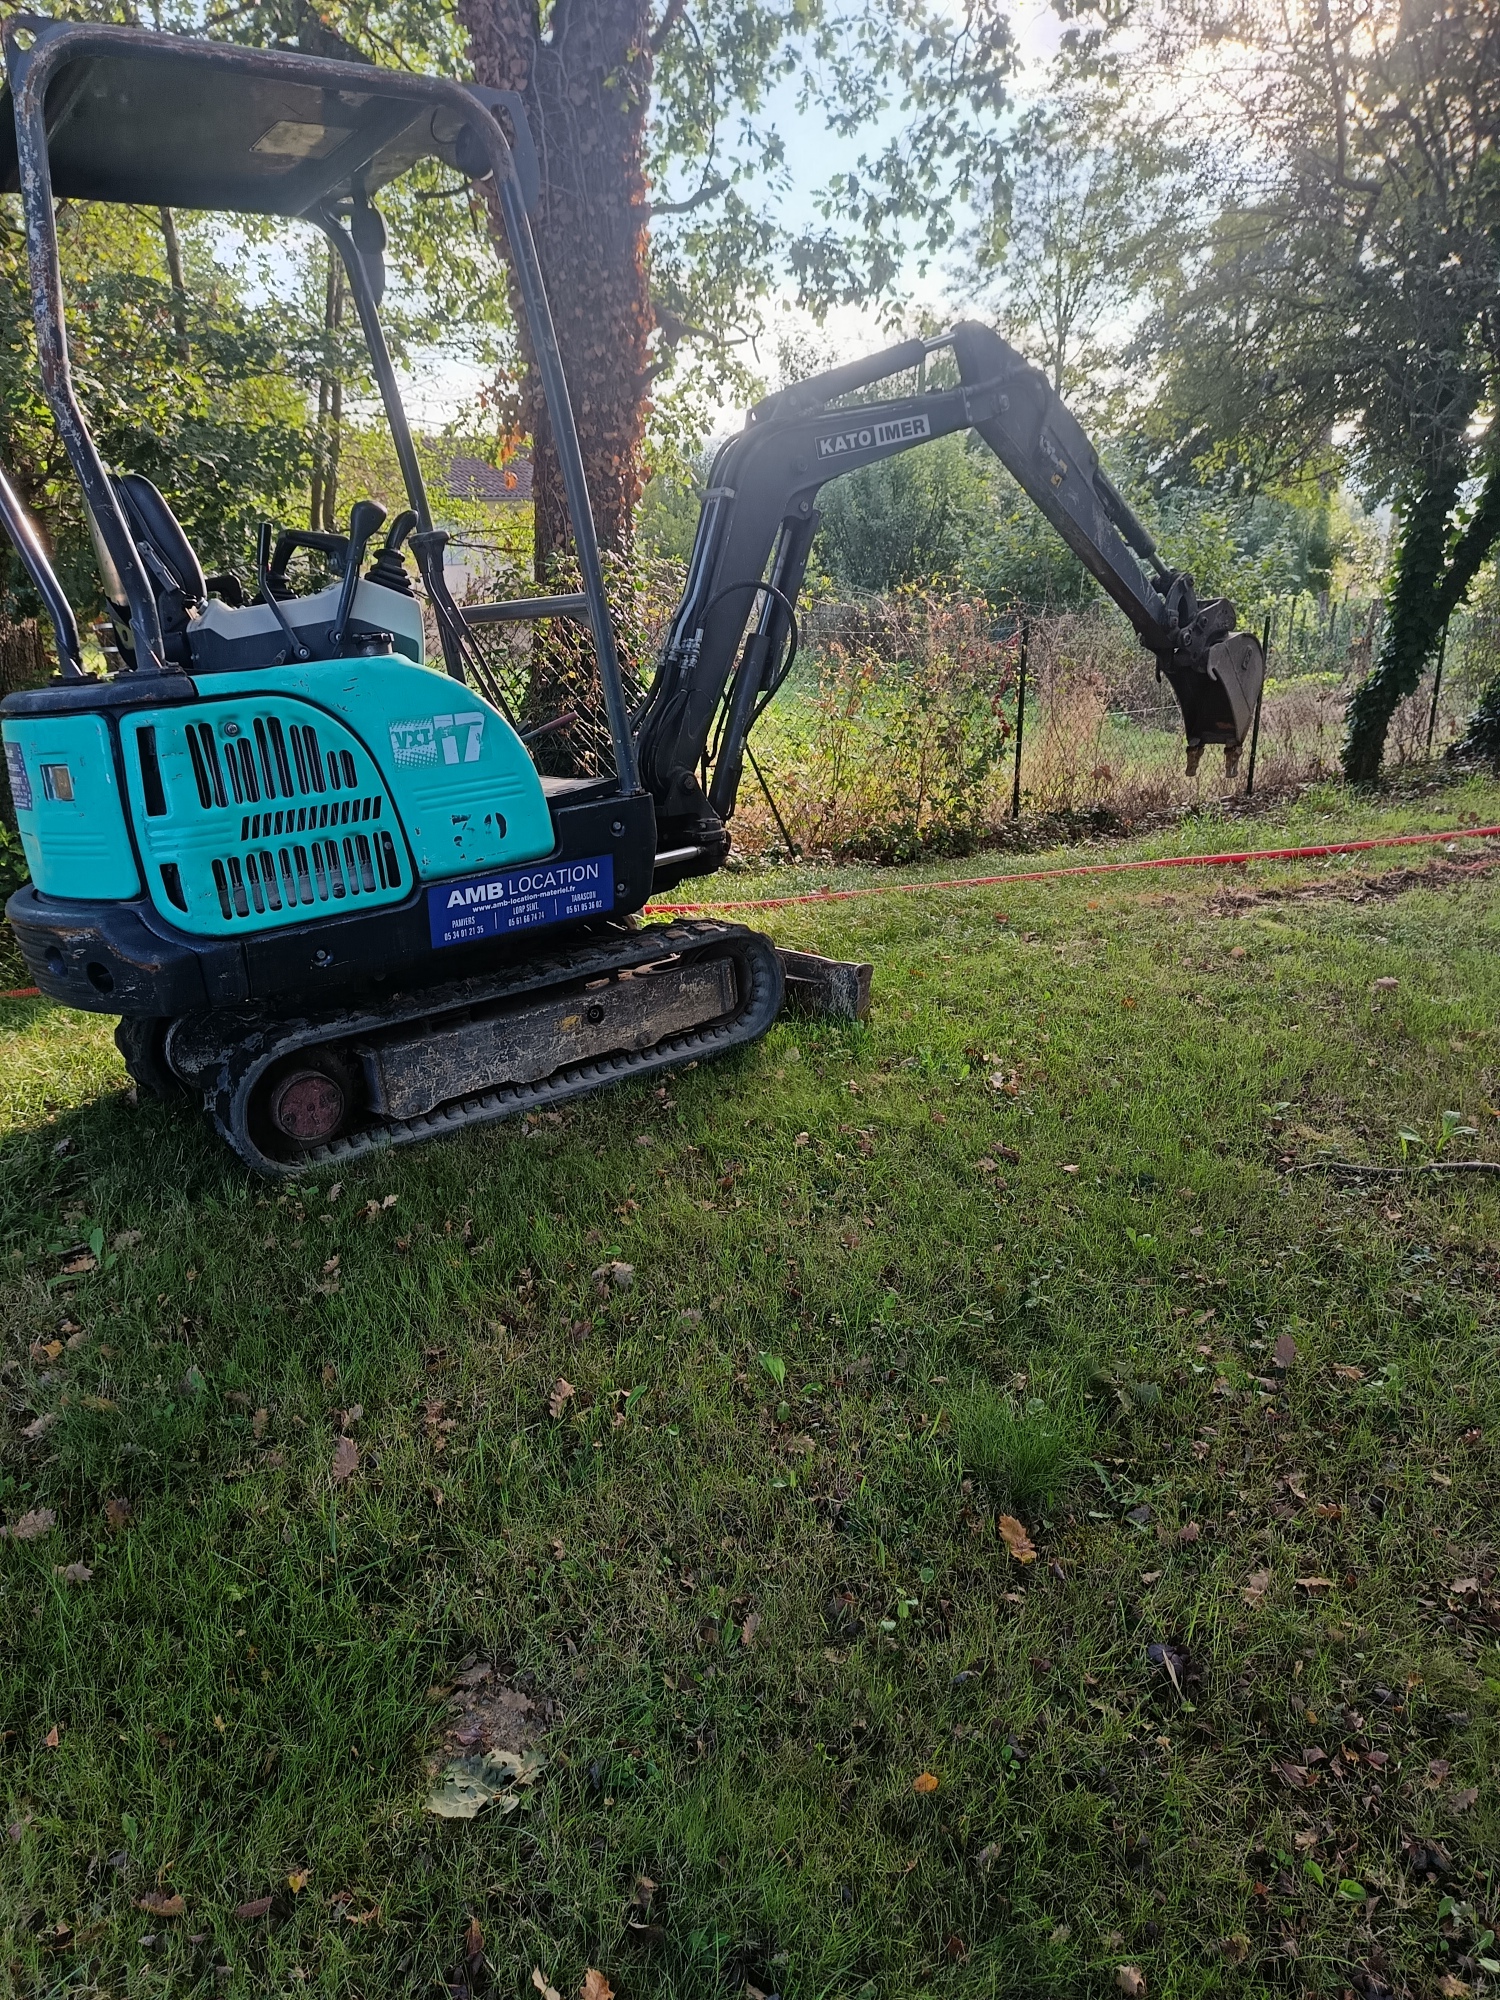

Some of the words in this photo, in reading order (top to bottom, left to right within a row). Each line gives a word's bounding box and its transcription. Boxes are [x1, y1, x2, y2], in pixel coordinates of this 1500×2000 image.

[820, 430, 872, 455] KATO
[878, 418, 926, 443] IMER
[446, 882, 505, 908] AMB
[508, 863, 599, 895] LOCATION
[472, 884, 576, 913] www.amb-location-materiel.fr
[571, 890, 597, 903] TARASCON
[566, 905, 574, 914] 05
[573, 904, 580, 913] 61
[508, 917, 516, 927] 05
[444, 932, 452, 941] 05
[452, 930, 460, 940] 34
[460, 928, 468, 938] 01
[468, 926, 476, 936] 21
[476, 925, 484, 935] 35
